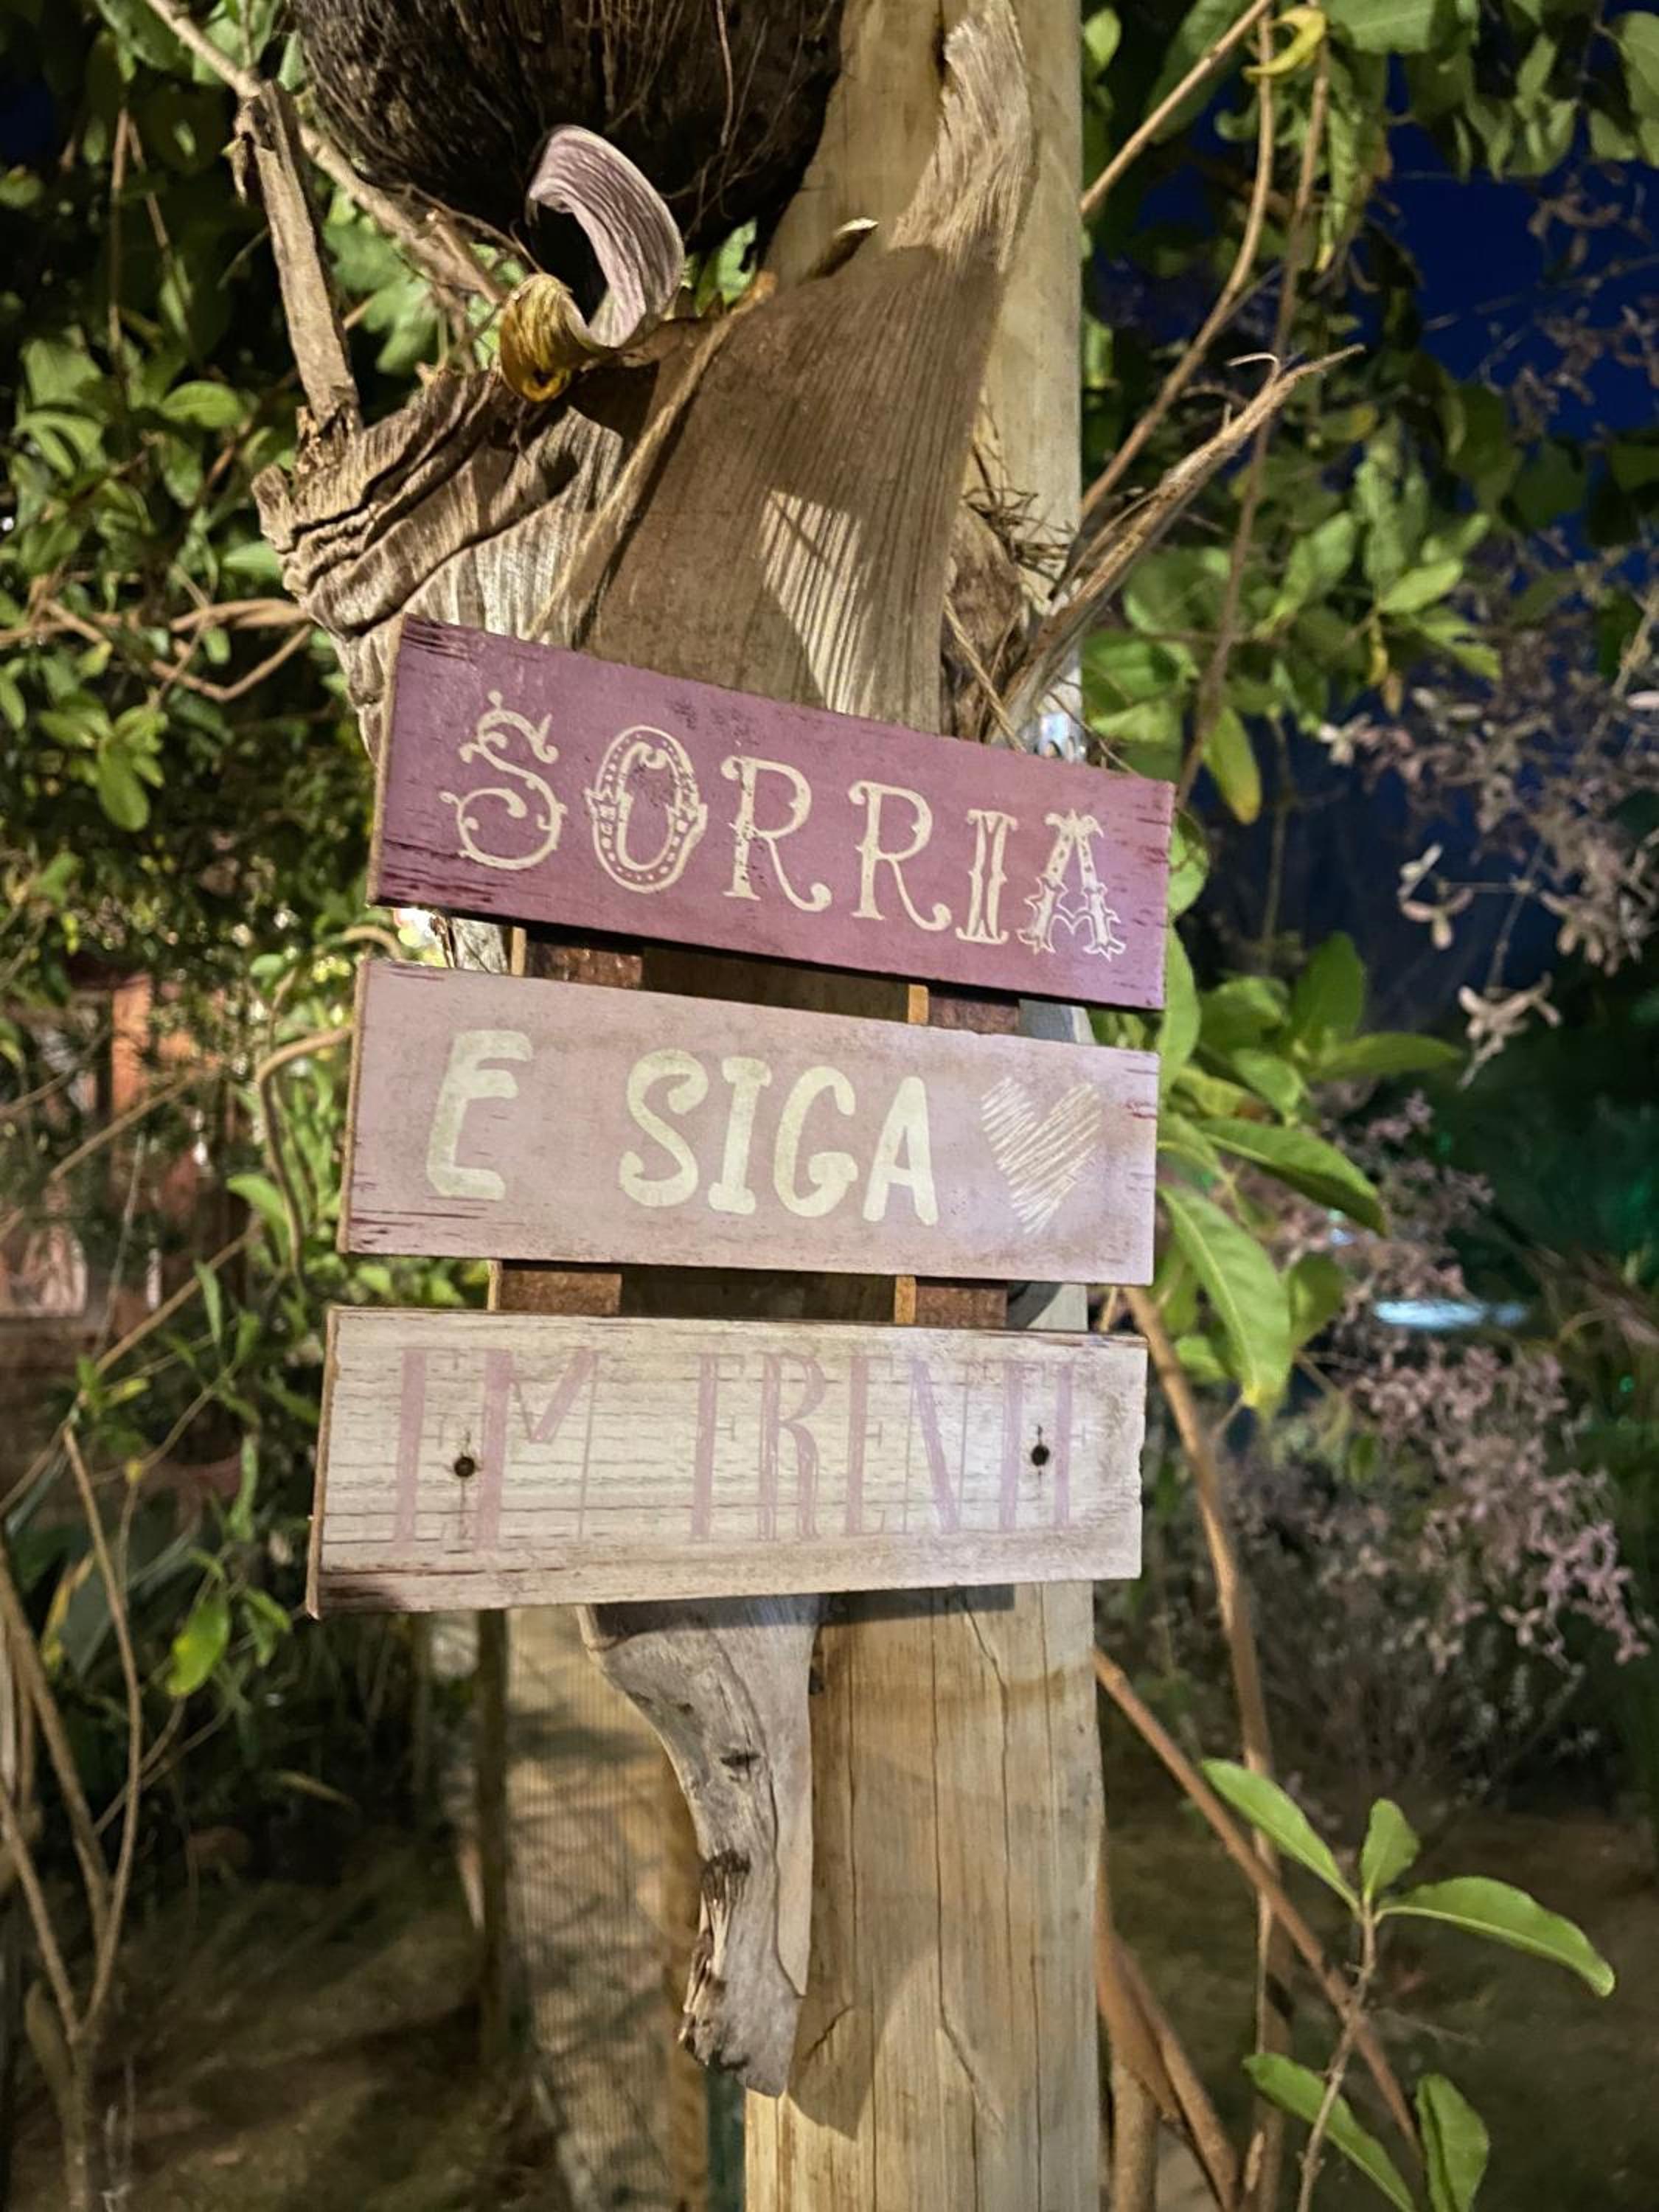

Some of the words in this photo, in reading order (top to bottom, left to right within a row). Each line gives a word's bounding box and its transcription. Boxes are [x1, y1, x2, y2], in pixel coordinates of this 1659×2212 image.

[440, 689, 1127, 961] SORRIA
[425, 1029, 534, 1201] E
[618, 1048, 939, 1226] SIGA
[390, 1345, 604, 1557] EM
[686, 1349, 1090, 1543] FRENTE
